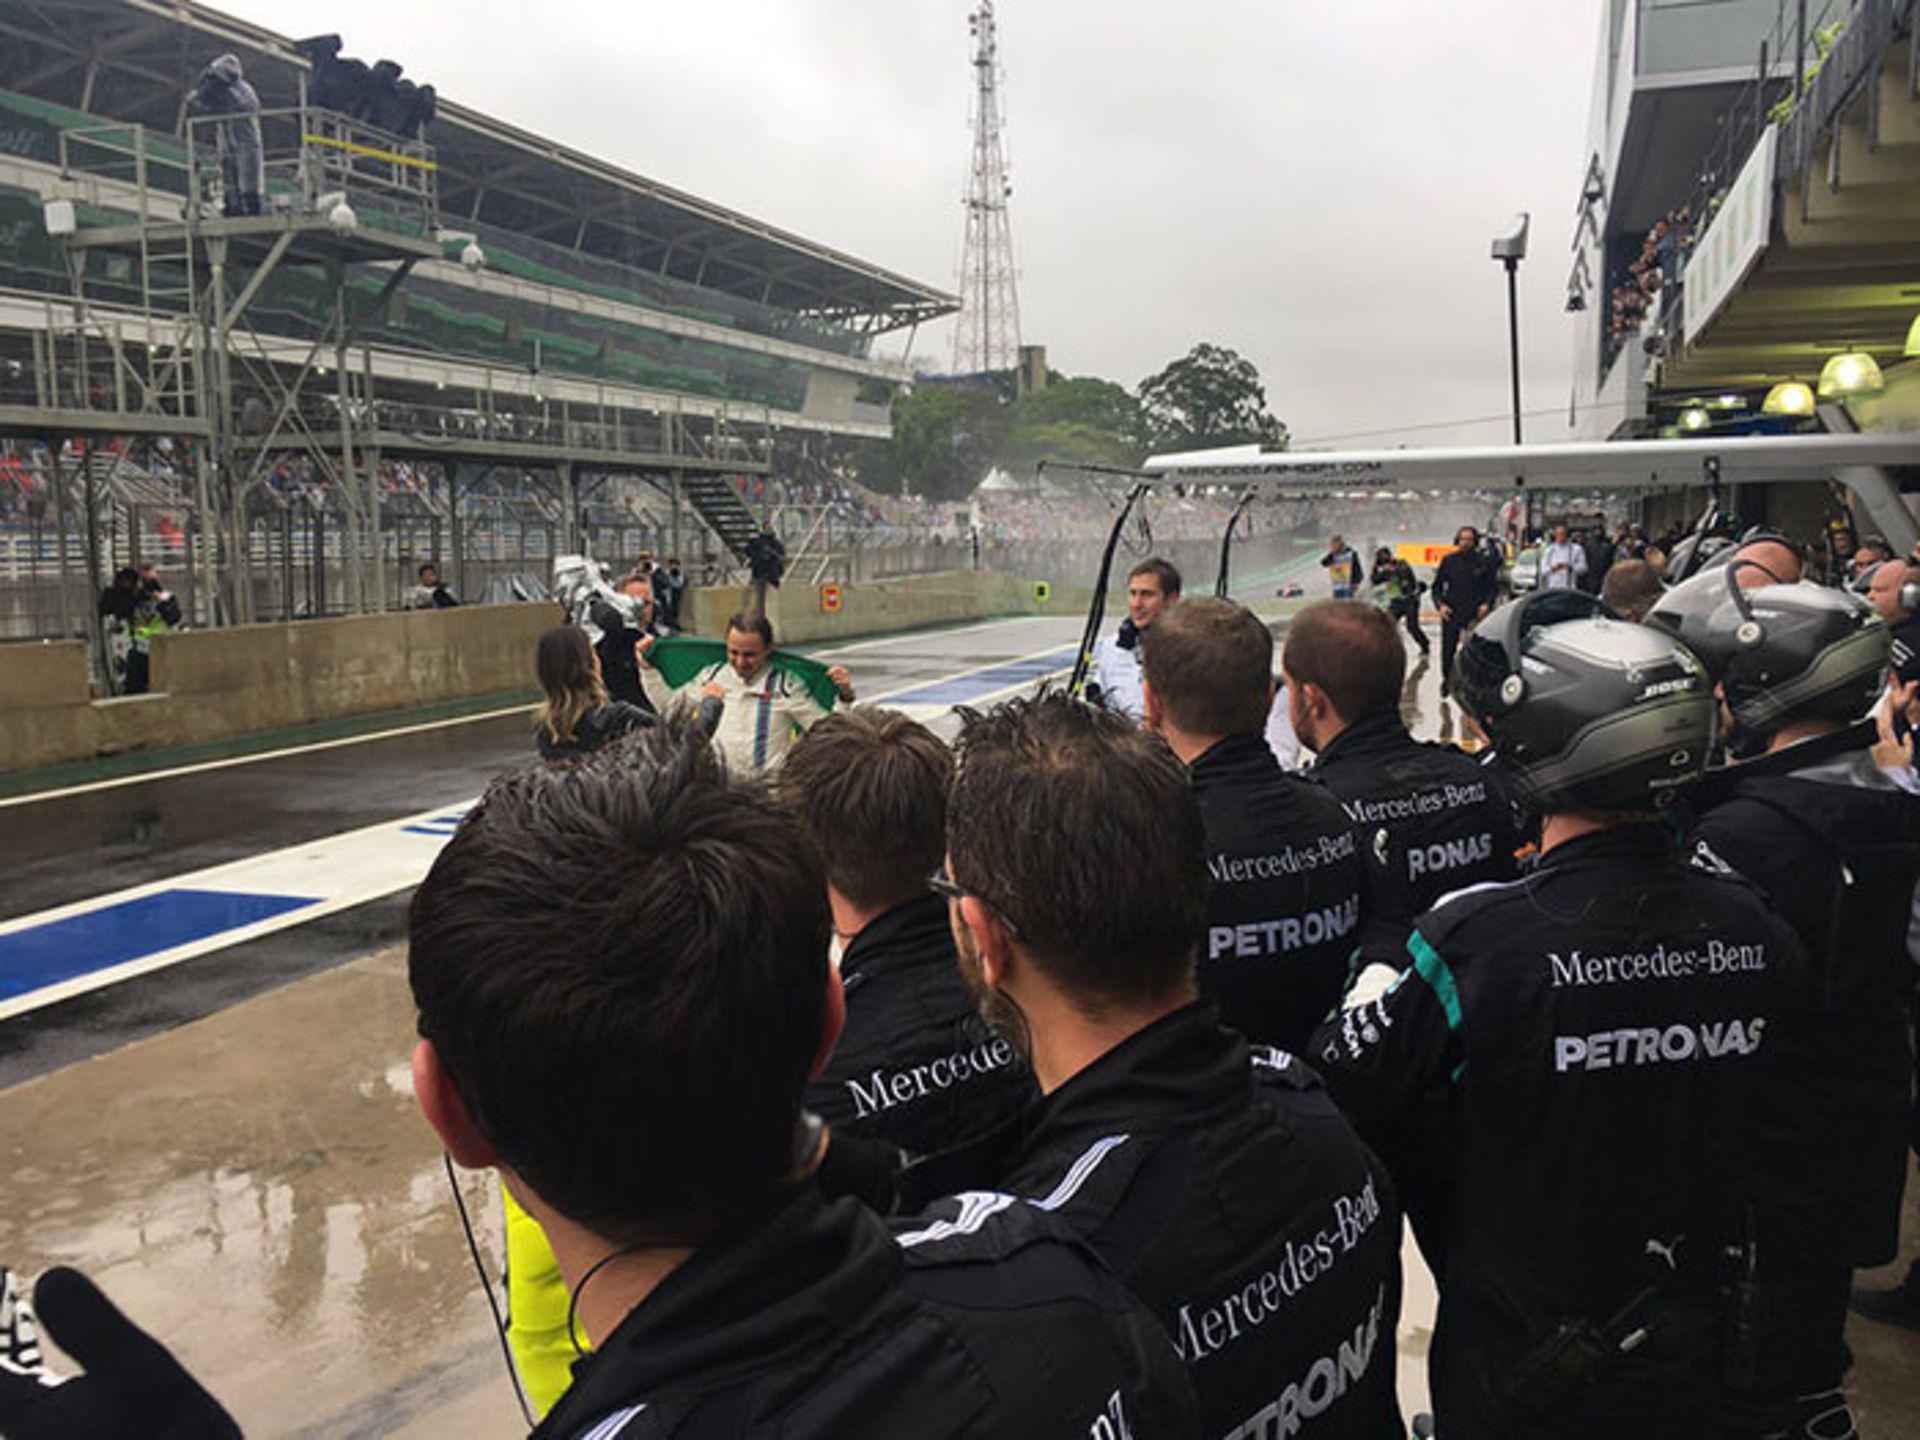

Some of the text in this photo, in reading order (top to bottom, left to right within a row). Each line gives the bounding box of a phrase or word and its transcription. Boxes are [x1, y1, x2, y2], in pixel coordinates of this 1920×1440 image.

[1407, 833, 1493, 883] RONAS
[1547, 940, 1766, 988] Mercedes-Benz
[1555, 1017, 1766, 1072] PETRONAS
[845, 1037, 1014, 1120] Mercede
